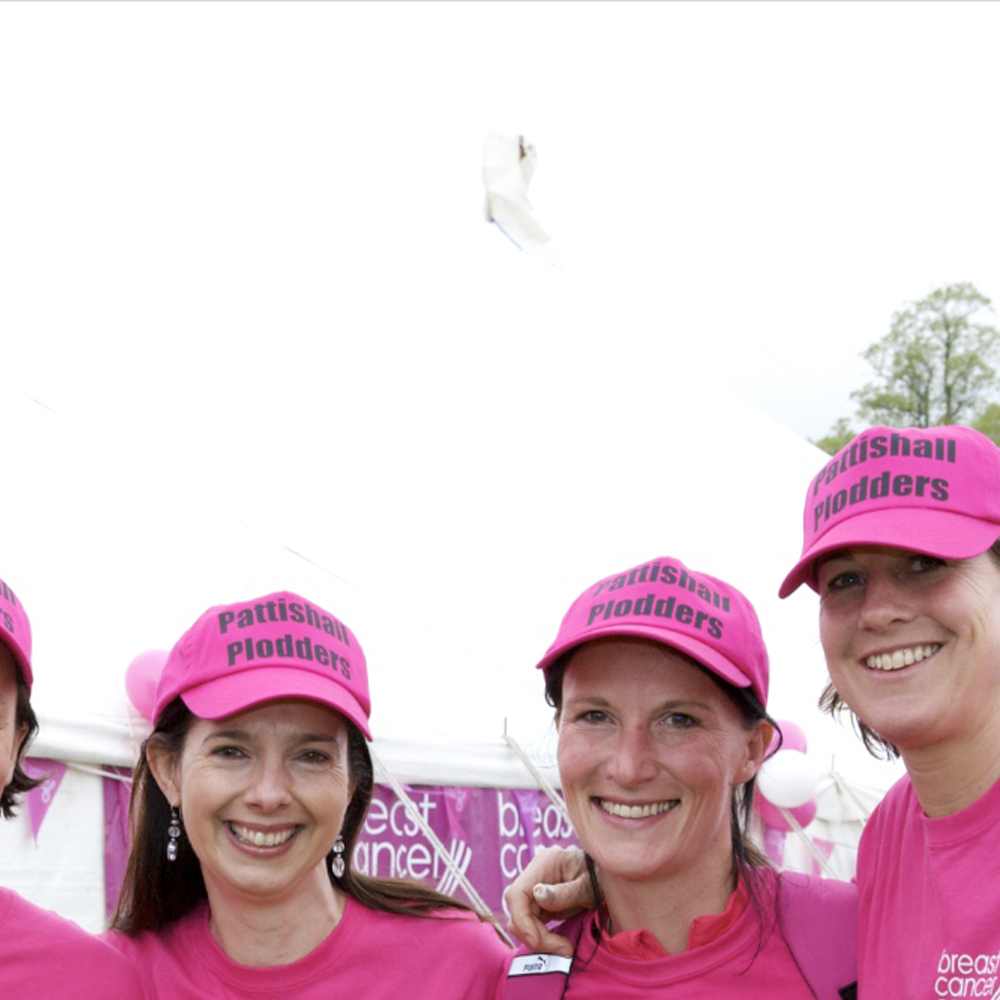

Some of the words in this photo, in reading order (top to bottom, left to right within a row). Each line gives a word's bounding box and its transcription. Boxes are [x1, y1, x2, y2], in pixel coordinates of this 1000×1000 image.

[813, 433, 956, 496] Pattishall
[814, 471, 950, 533] Plodders
[593, 561, 731, 613] Pattishall
[218, 598, 350, 646] Pattishall
[586, 594, 724, 640] Plodders
[227, 634, 351, 680] Plodders
